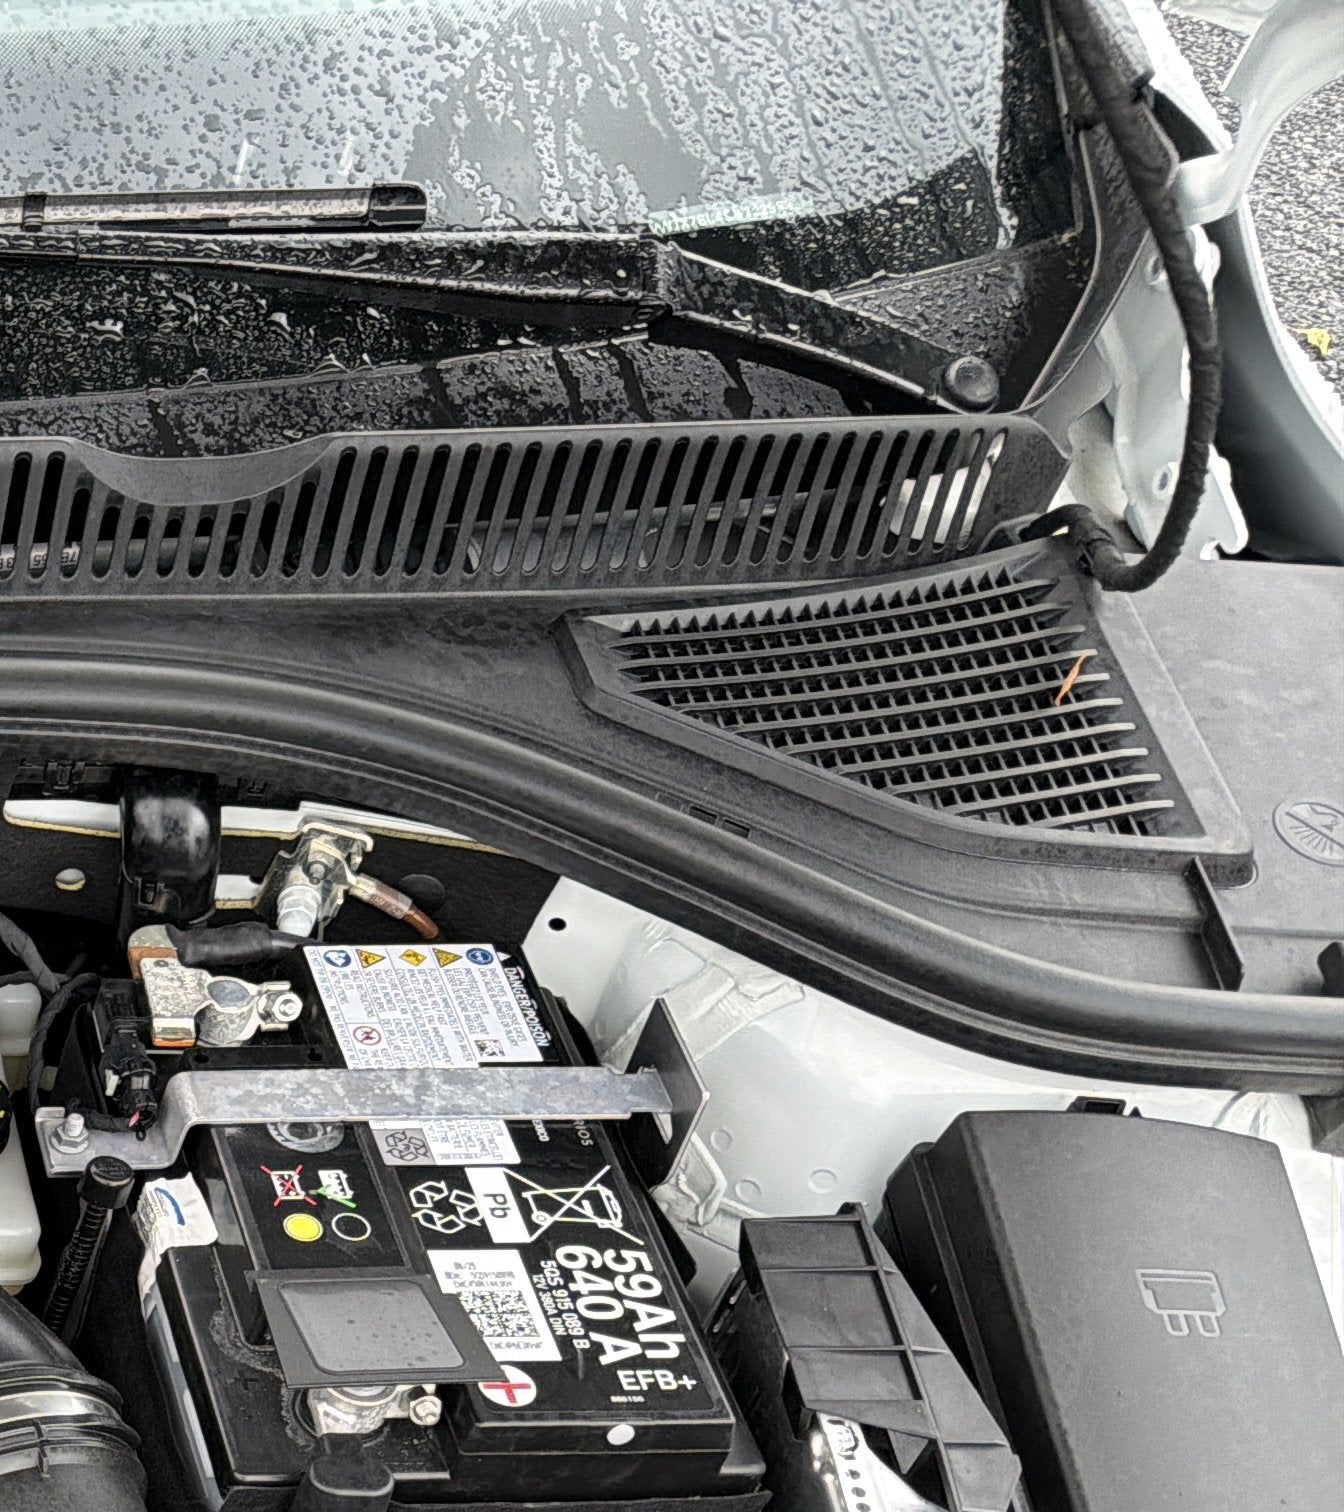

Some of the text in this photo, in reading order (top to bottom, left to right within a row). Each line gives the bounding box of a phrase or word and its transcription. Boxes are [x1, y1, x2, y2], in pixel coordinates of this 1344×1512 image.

[482, 1193, 509, 1218] Pb
[555, 1245, 625, 1321] 640
[553, 1288, 574, 1310] 915
[603, 1249, 687, 1359] 59Ah
[550, 1317, 567, 1336] DIN
[589, 1331, 643, 1366] A
[616, 1369, 697, 1392] EFB+
